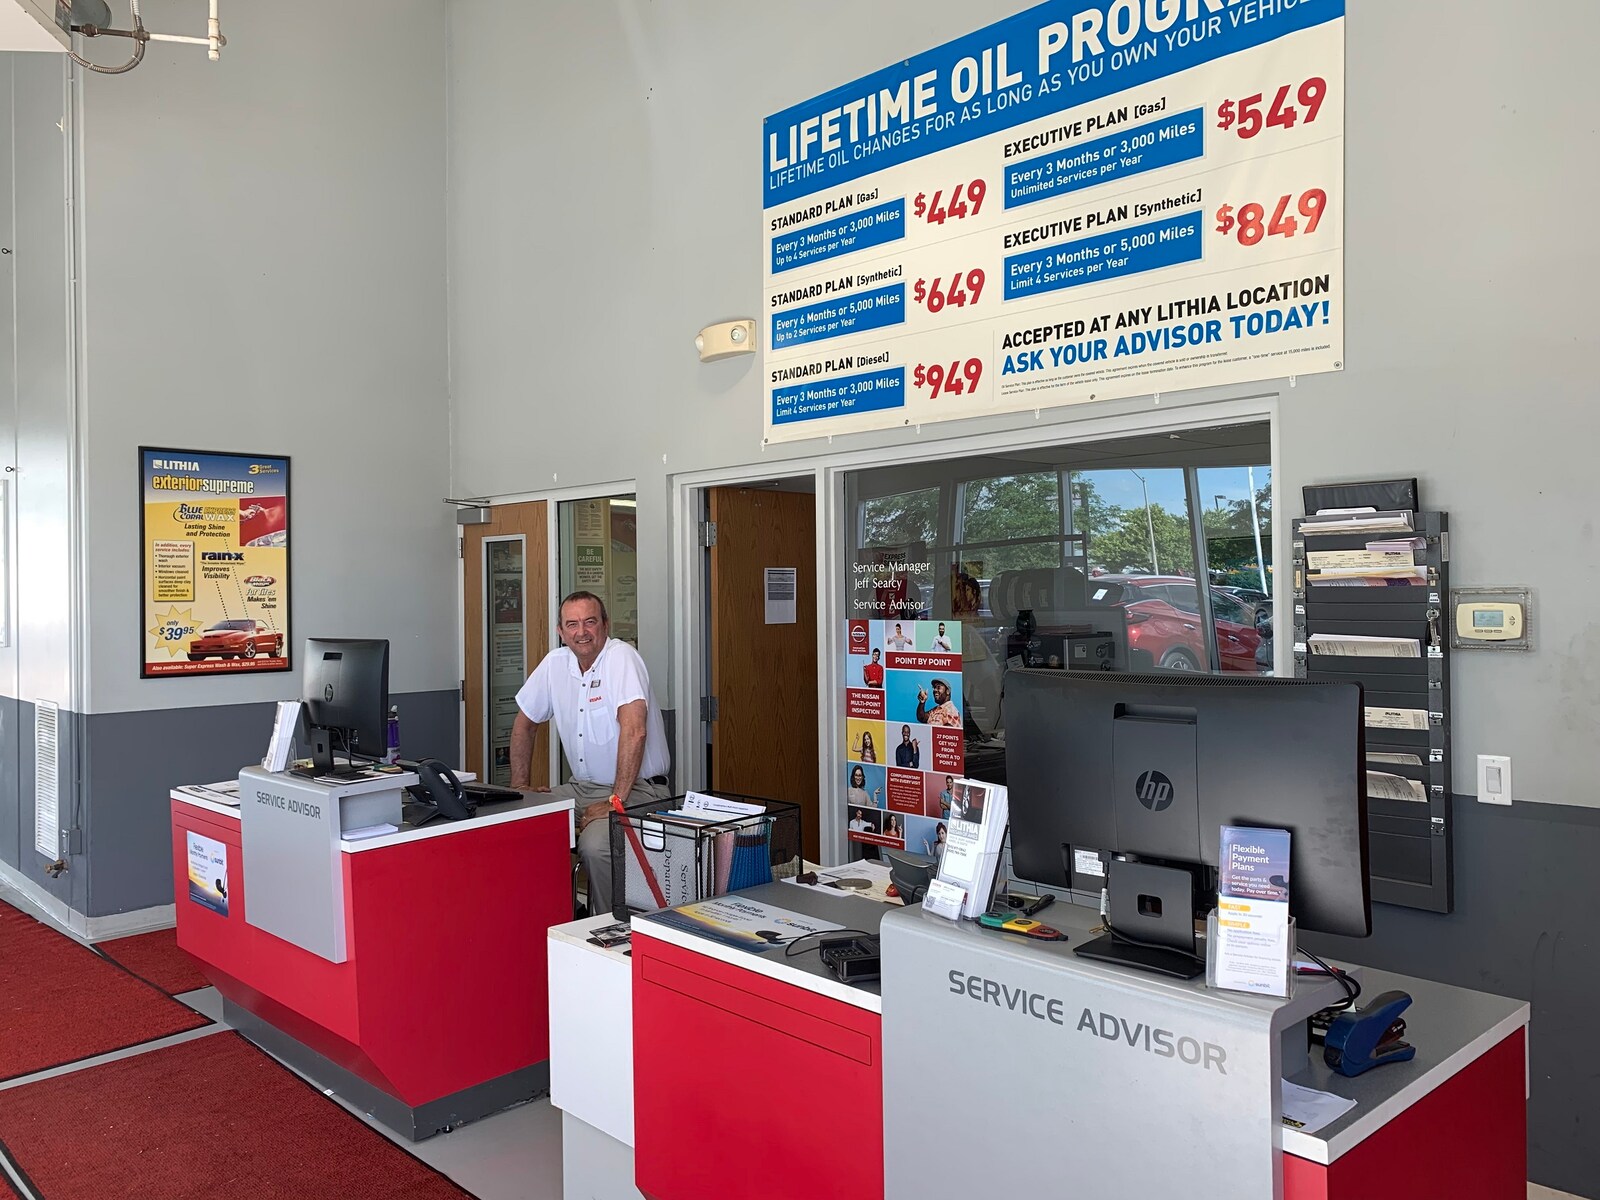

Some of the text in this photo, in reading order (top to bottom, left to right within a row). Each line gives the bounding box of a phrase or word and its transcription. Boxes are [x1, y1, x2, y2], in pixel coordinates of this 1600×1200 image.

[770, 0, 1241, 172] LIFETIME OIL PROG
[770, 0, 1311, 190] LIFETIME OIL CHANGES FOR AS LONG AS YOU OWN YOUR VEHI
[1217, 77, 1327, 140] $549
[1004, 97, 1166, 158] EXECUTIVE PLAN [Gas]
[1011, 122, 1196, 186] Every 3 Months or 3,000 Miles
[1011, 154, 1143, 198] Unlimited Services per Year
[771, 188, 878, 232] STANDARD PLAN [Gas]
[914, 178, 987, 226] $449
[1004, 188, 1202, 249] EXECUTIVE PLAN [Synthetic]
[1216, 188, 1327, 246] $849
[776, 210, 900, 254] Every 3 Months or 3,000 Miles
[776, 257, 785, 266] Up
[793, 252, 798, 261] 4
[798, 246, 826, 260] Services
[827, 242, 840, 252] per
[840, 236, 856, 247] Year
[1010, 224, 1194, 277] Every 3 Months or 5,000 Miles
[771, 265, 902, 308] STANDARD PLAN [Synthetic]
[914, 268, 985, 314] $649
[1010, 256, 1129, 290] Limit 4 Services per Year
[776, 294, 900, 332] Every 6 Months or 5,000 Miles
[776, 333, 785, 342] Up
[793, 329, 798, 338] 2
[798, 324, 826, 337] Services
[827, 321, 839, 331] per
[840, 317, 856, 326] Year
[1002, 274, 1330, 350] ACCEPTED AT ANY LITHIA LOCATION
[1002, 300, 1330, 376] ASK YOUR ADVISOR TODAY!
[771, 352, 890, 382] STANDARD PLAN [Diesel]
[913, 358, 983, 399] $949
[776, 378, 900, 407] Every 3 Months or 3,000 Miles
[776, 398, 856, 416] Limit 4 Services per Year
[163, 460, 200, 472] LITHIA
[248, 464, 260, 475] 3
[179, 503, 204, 514] BLUE
[205, 514, 236, 522] WAX
[586, 548, 594, 556] BE
[852, 562, 885, 572] Service
[888, 562, 930, 574] Manager
[204, 572, 230, 580] Visibility
[854, 578, 902, 590] Jeff Searcy
[854, 598, 925, 610] Service Advisor
[895, 657, 951, 666] POINT BY POINT
[850, 700, 881, 708] MULTI-POINT
[256, 791, 321, 820] SERVICE ADVISOR
[1137, 770, 1173, 811] hp
[1232, 844, 1266, 854] Flexible
[1232, 853, 1269, 864] Payment
[1232, 862, 1254, 872] Plans
[680, 864, 688, 904] Servic
[948, 969, 1228, 1076] SERVICE ADVISOR
